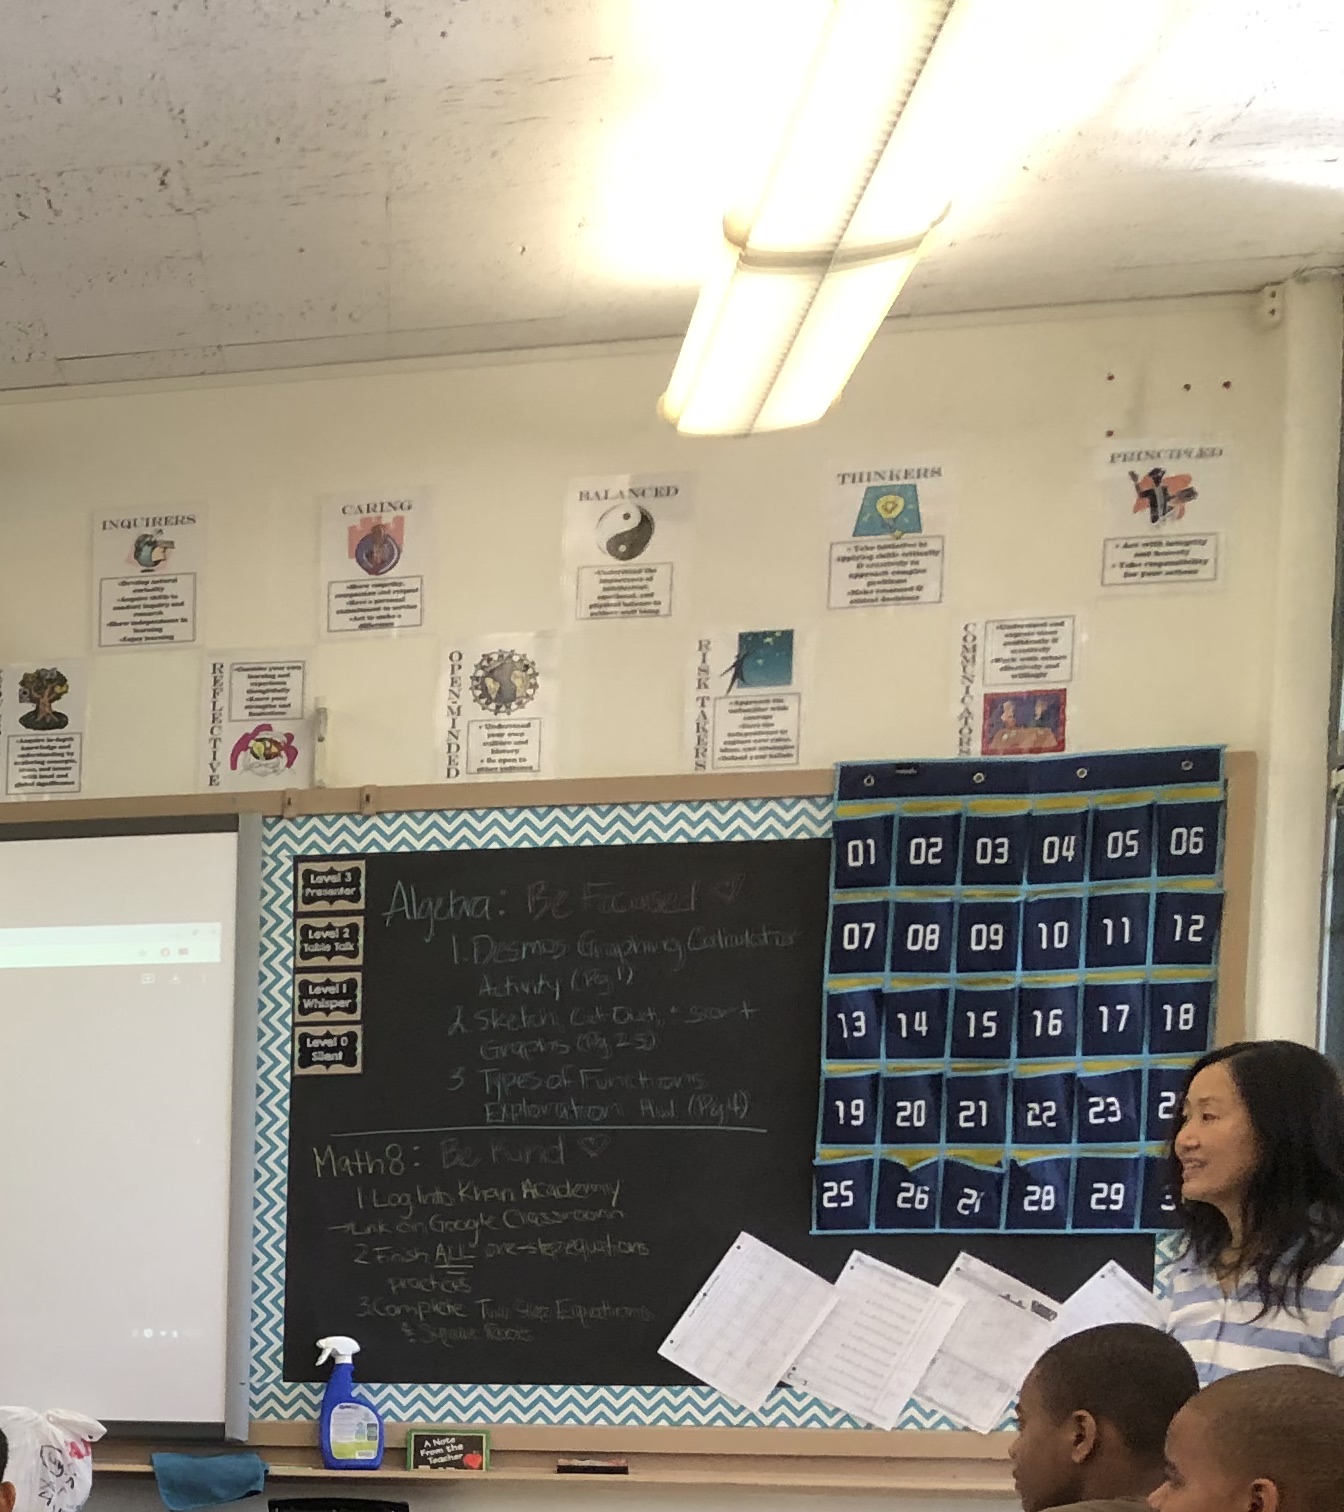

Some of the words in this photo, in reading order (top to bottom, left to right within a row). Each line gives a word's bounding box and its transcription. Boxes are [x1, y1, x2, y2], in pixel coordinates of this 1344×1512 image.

[837, 467, 943, 485] THINKERS
[579, 486, 679, 501] BALANCED
[342, 501, 413, 515] CARING
[102, 515, 196, 530] INQUIRERS
[208, 663, 224, 787] REFLECTIVE
[446, 650, 463, 779] OPEN-MINDED
[847, 839, 876, 867] 01
[909, 837, 942, 865] 02
[975, 837, 1009, 864] 03
[1042, 835, 1075, 864] 04
[1107, 830, 1139, 859] 05
[1170, 826, 1204, 856] 06
[310, 873, 341, 884] Level
[344, 872, 352, 882] 3
[527, 880, 575, 922] Be
[308, 929, 339, 940] Level
[343, 928, 350, 938] 2
[843, 922, 876, 950] 07
[907, 923, 939, 951] 08
[970, 923, 1003, 951] 09
[1038, 921, 1069, 949] 10
[1103, 917, 1130, 944] 11
[1173, 914, 1204, 942] 12
[308, 984, 340, 995] Level
[303, 998, 352, 1011] Whisper
[1162, 1003, 1194, 1031] 18
[836, 1011, 866, 1039] 13
[897, 1011, 928, 1038] 14
[966, 1010, 997, 1038] 15
[1032, 1008, 1063, 1036] 16
[1098, 1004, 1130, 1033] 17
[306, 1037, 338, 1048] Level
[341, 1036, 348, 1046] 0
[311, 1051, 344, 1062] Silent
[477, 1068, 542, 1102] Types
[546, 1065, 577, 1090] of
[835, 1099, 865, 1126] 19
[895, 1100, 926, 1127] 20
[959, 1100, 988, 1127] 21
[1026, 1101, 1056, 1127] 22
[1087, 1096, 1121, 1124] 23
[1157, 1092, 1177, 1120] 2
[440, 1137, 481, 1169] Be
[822, 1180, 854, 1208] 25
[896, 1182, 930, 1209] 26
[1023, 1185, 1056, 1211] 28
[1090, 1183, 1125, 1210] 29
[434, 1241, 477, 1263] ALL
[420, 1448, 444, 1457] From
[445, 1443, 464, 1453] the
[424, 1440, 432, 1448] A
[433, 1436, 456, 1446] Note
[427, 1453, 464, 1465] Teacher
